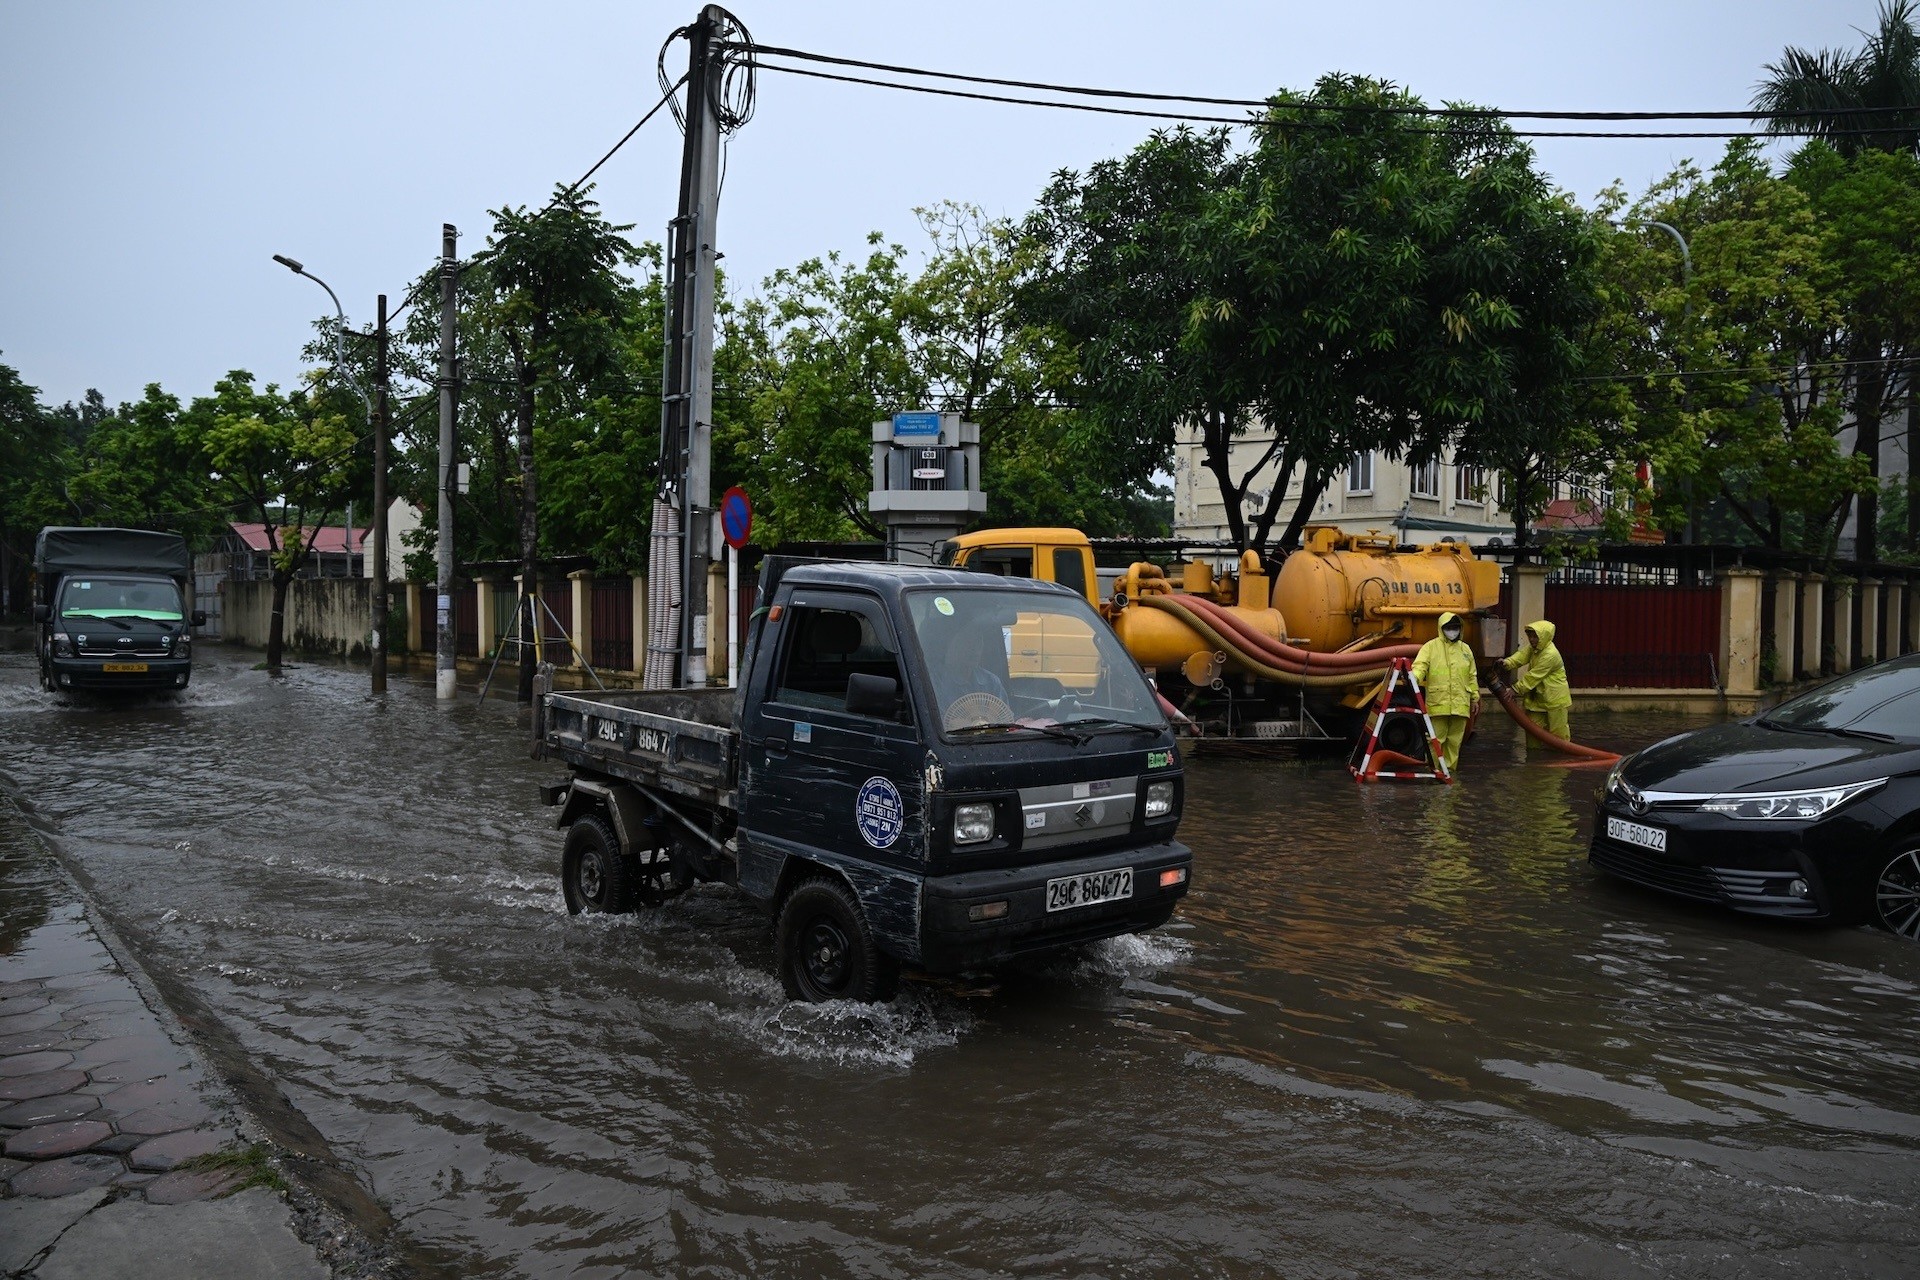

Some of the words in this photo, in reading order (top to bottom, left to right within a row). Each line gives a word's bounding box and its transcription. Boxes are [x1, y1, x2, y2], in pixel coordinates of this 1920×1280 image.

[1415, 582, 1440, 594] 040
[1446, 582, 1463, 594] 13
[876, 807, 886, 817] 951
[881, 821, 890, 832] 2N
[1609, 820, 1664, 849] 30F-560.22
[1049, 880, 1077, 908] 29C
